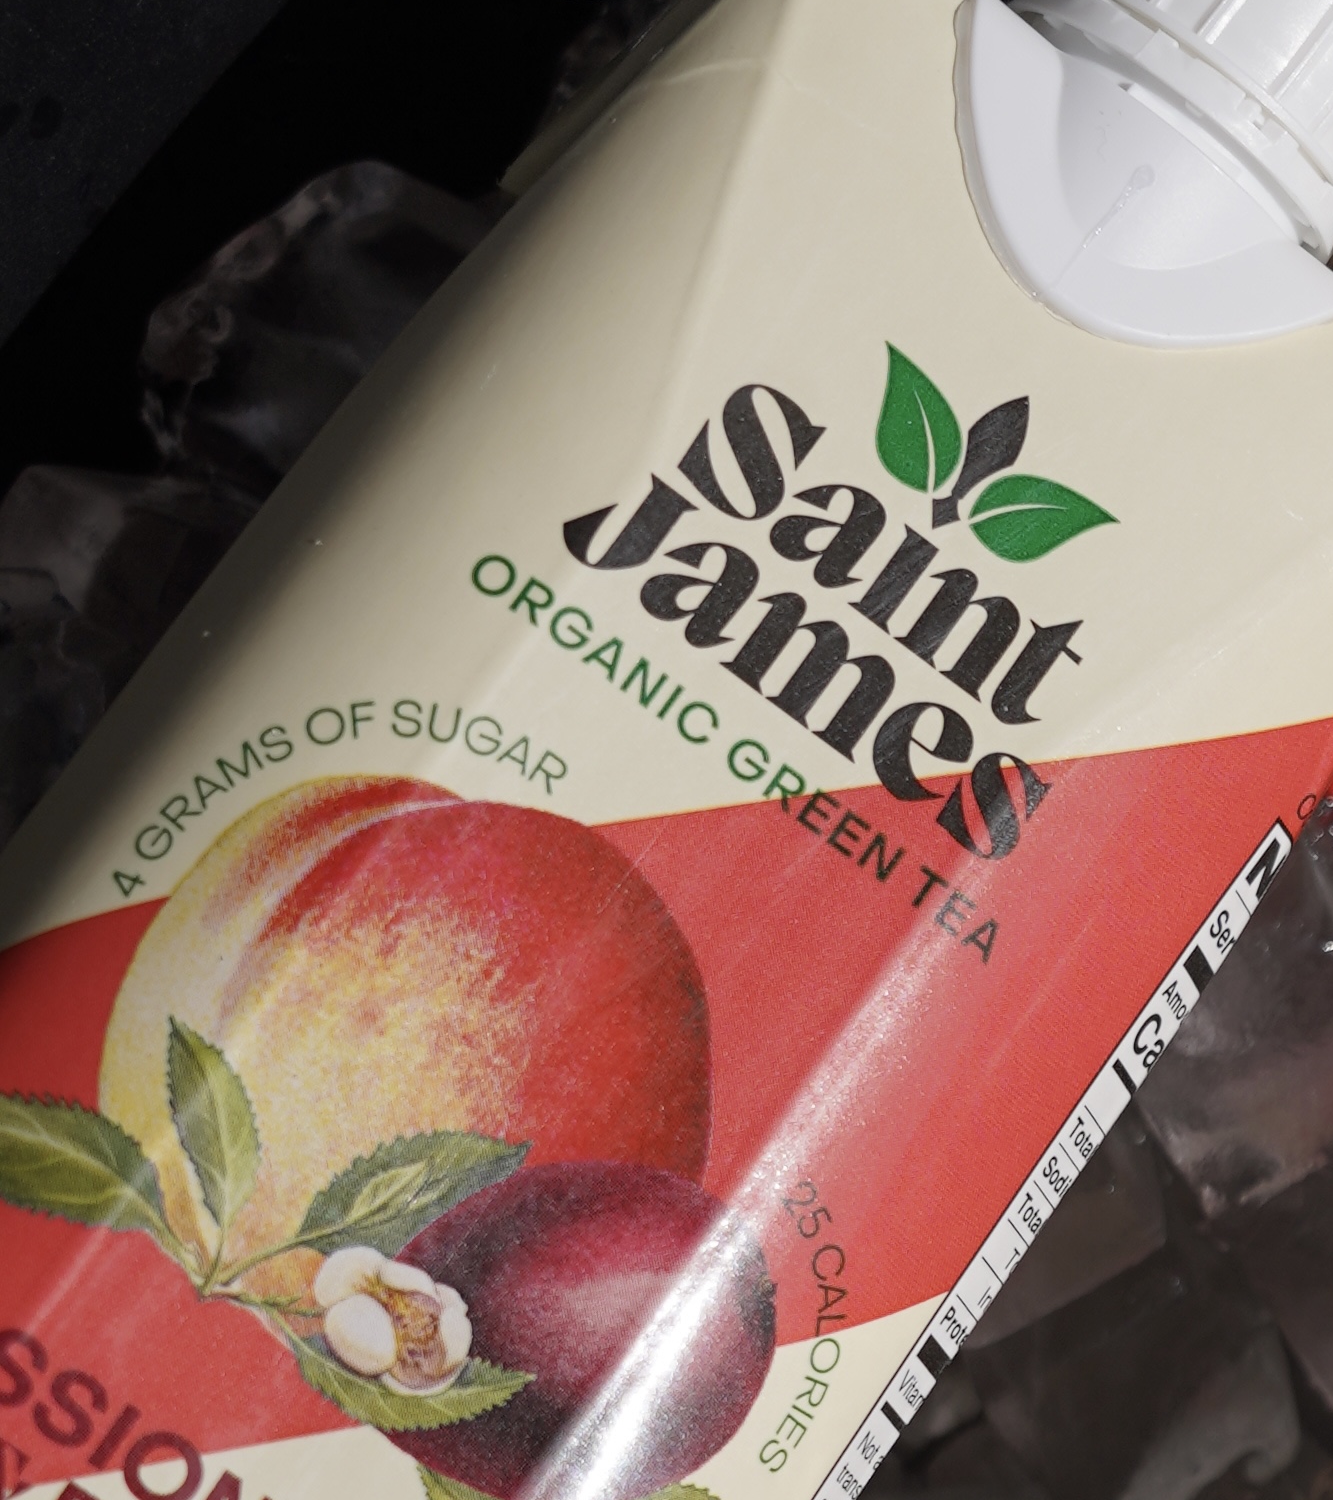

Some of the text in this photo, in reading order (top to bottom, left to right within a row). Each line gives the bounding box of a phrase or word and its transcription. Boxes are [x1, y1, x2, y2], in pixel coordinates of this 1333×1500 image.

[563, 473, 1052, 860] James
[678, 384, 1084, 724] Saint
[111, 699, 569, 898] 4 GRAMS OF SUGAR
[470, 554, 1000, 964] ORGANIC GREEN TEA
[759, 1181, 848, 1474] 25 CALORIES
